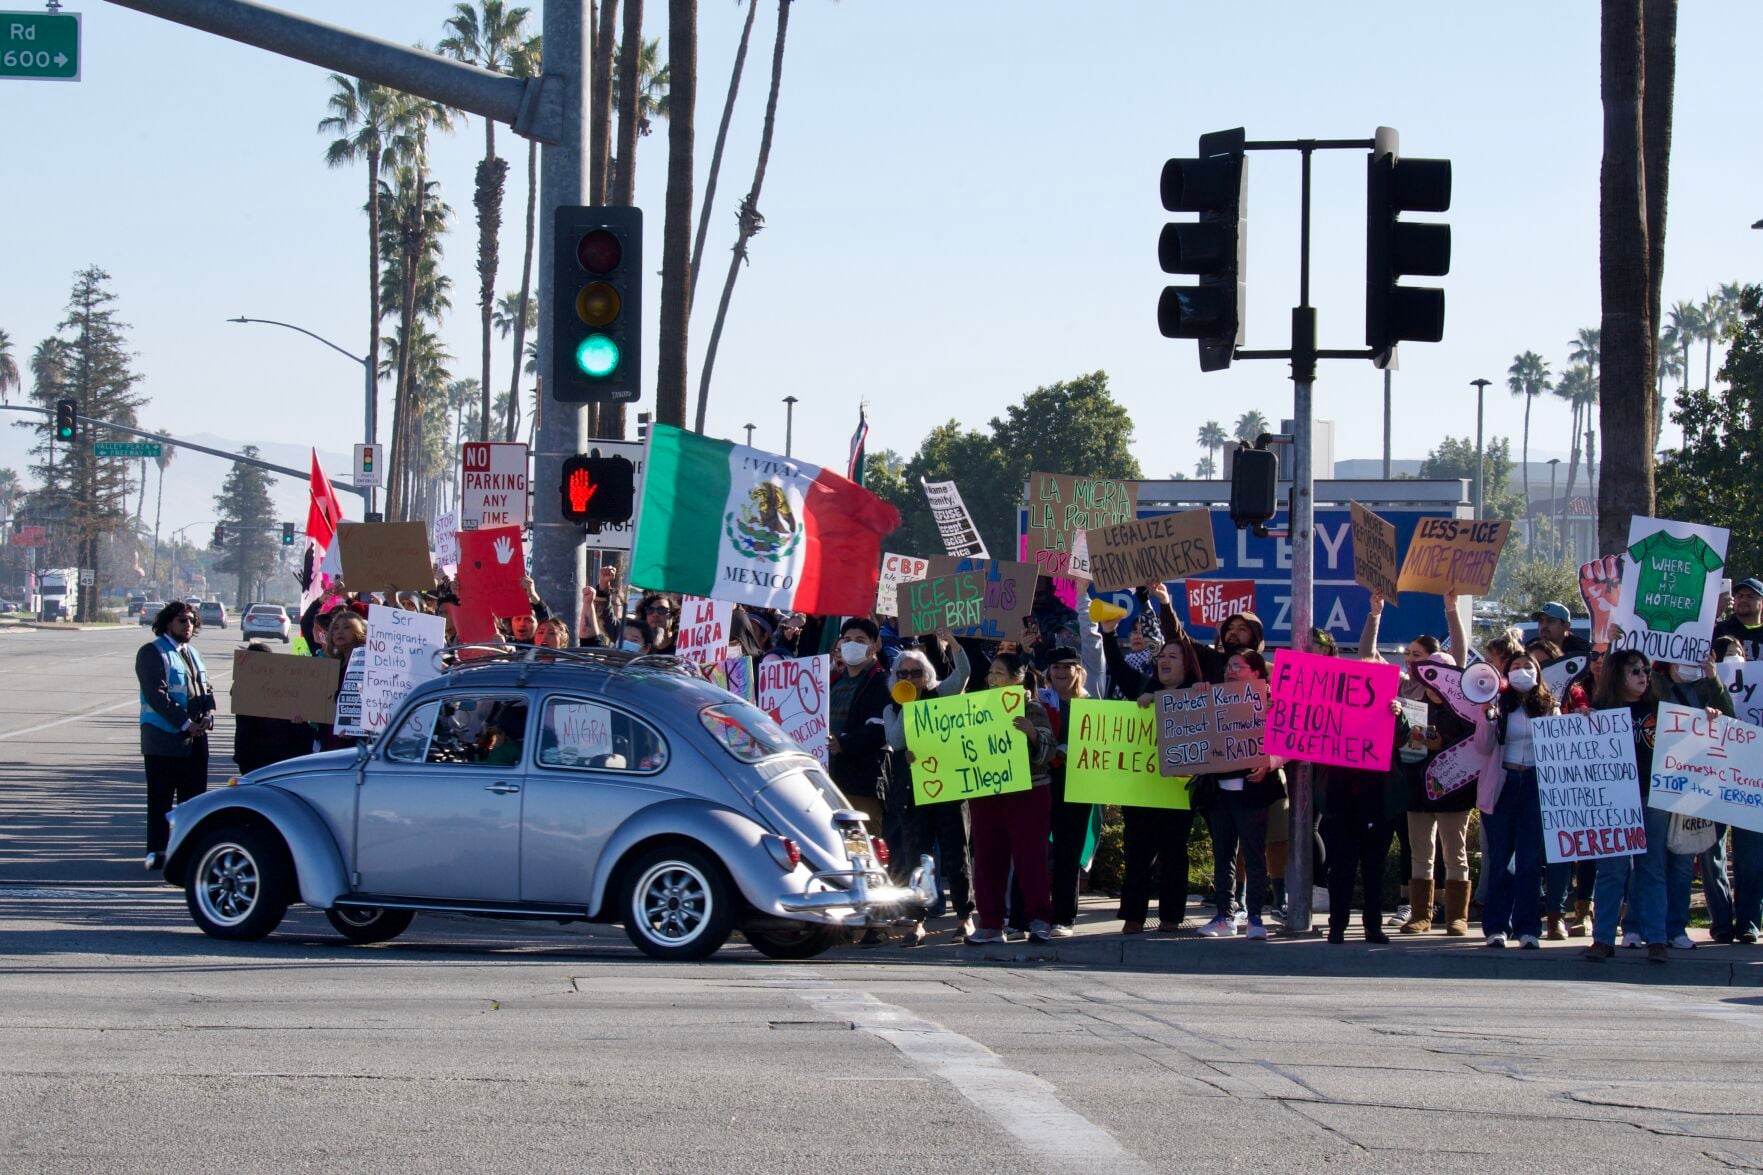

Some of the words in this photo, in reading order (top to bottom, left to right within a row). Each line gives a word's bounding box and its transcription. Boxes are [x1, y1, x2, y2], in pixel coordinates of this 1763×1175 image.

[10, 23, 36, 41] Rd
[0, 50, 50, 68] 600
[466, 447, 487, 467] NO
[466, 473, 525, 491] PARKING
[482, 495, 508, 507] ANY
[435, 513, 454, 533] STOP
[1103, 518, 1175, 547] LEGALIZE
[886, 556, 925, 576] CBP
[1129, 538, 1210, 582] WORKERS
[1651, 557, 1692, 575] WHERE
[723, 565, 793, 590] MEXICO
[1659, 582, 1676, 593] MY
[1662, 572, 1677, 584] IS
[910, 577, 946, 611] ICE
[955, 574, 979, 604] IS
[1207, 583, 1223, 604] SE
[1645, 592, 1696, 610] MOTHER?
[391, 610, 414, 626] Ser
[696, 601, 714, 624] LA
[910, 610, 943, 636] NOT
[945, 597, 984, 627] BRAT
[369, 624, 428, 646] Immigrante
[677, 622, 722, 650] MIGRA
[1641, 630, 1670, 659] YOU
[369, 639, 386, 653] NO
[393, 645, 404, 655] es
[409, 648, 424, 656] un
[374, 654, 406, 668] Delito
[811, 656, 821, 674] A
[365, 698, 394, 711] estar
[761, 697, 775, 712] LA
[1163, 693, 1208, 713] Protect
[1212, 686, 1240, 706] Kern
[1243, 682, 1264, 712] Ag
[563, 715, 608, 746] MIGRA
[914, 697, 994, 743] Migration
[1112, 715, 1158, 746] HUM
[1164, 717, 1209, 738] Protect
[1533, 716, 1586, 739] MIGRAR
[1588, 714, 1612, 735] NO
[1613, 713, 1630, 734] ES
[961, 735, 978, 763] is
[988, 730, 1013, 756] Not
[1166, 740, 1209, 765] STOP
[1225, 736, 1265, 761] RAIDS
[1270, 728, 1380, 762] TOGETHER
[1535, 744, 1557, 763] UN
[1556, 739, 1605, 762] PLACER,
[1609, 738, 1623, 759] SI
[1077, 746, 1111, 770] ARE
[1665, 755, 1727, 782] Domestic
[955, 758, 1013, 795] Illegal
[1537, 766, 1557, 785] NO
[1556, 765, 1585, 784] UNA
[1584, 762, 1637, 782] NECESIDAD
[1539, 786, 1613, 808] INEVITABLE,
[1651, 774, 1689, 792] STOP
[1690, 782, 1713, 797] the
[1542, 809, 1608, 831] ENTONCES
[1607, 809, 1622, 827] ES
[1623, 808, 1643, 826] UN
[1558, 826, 1648, 858] DERECHO
